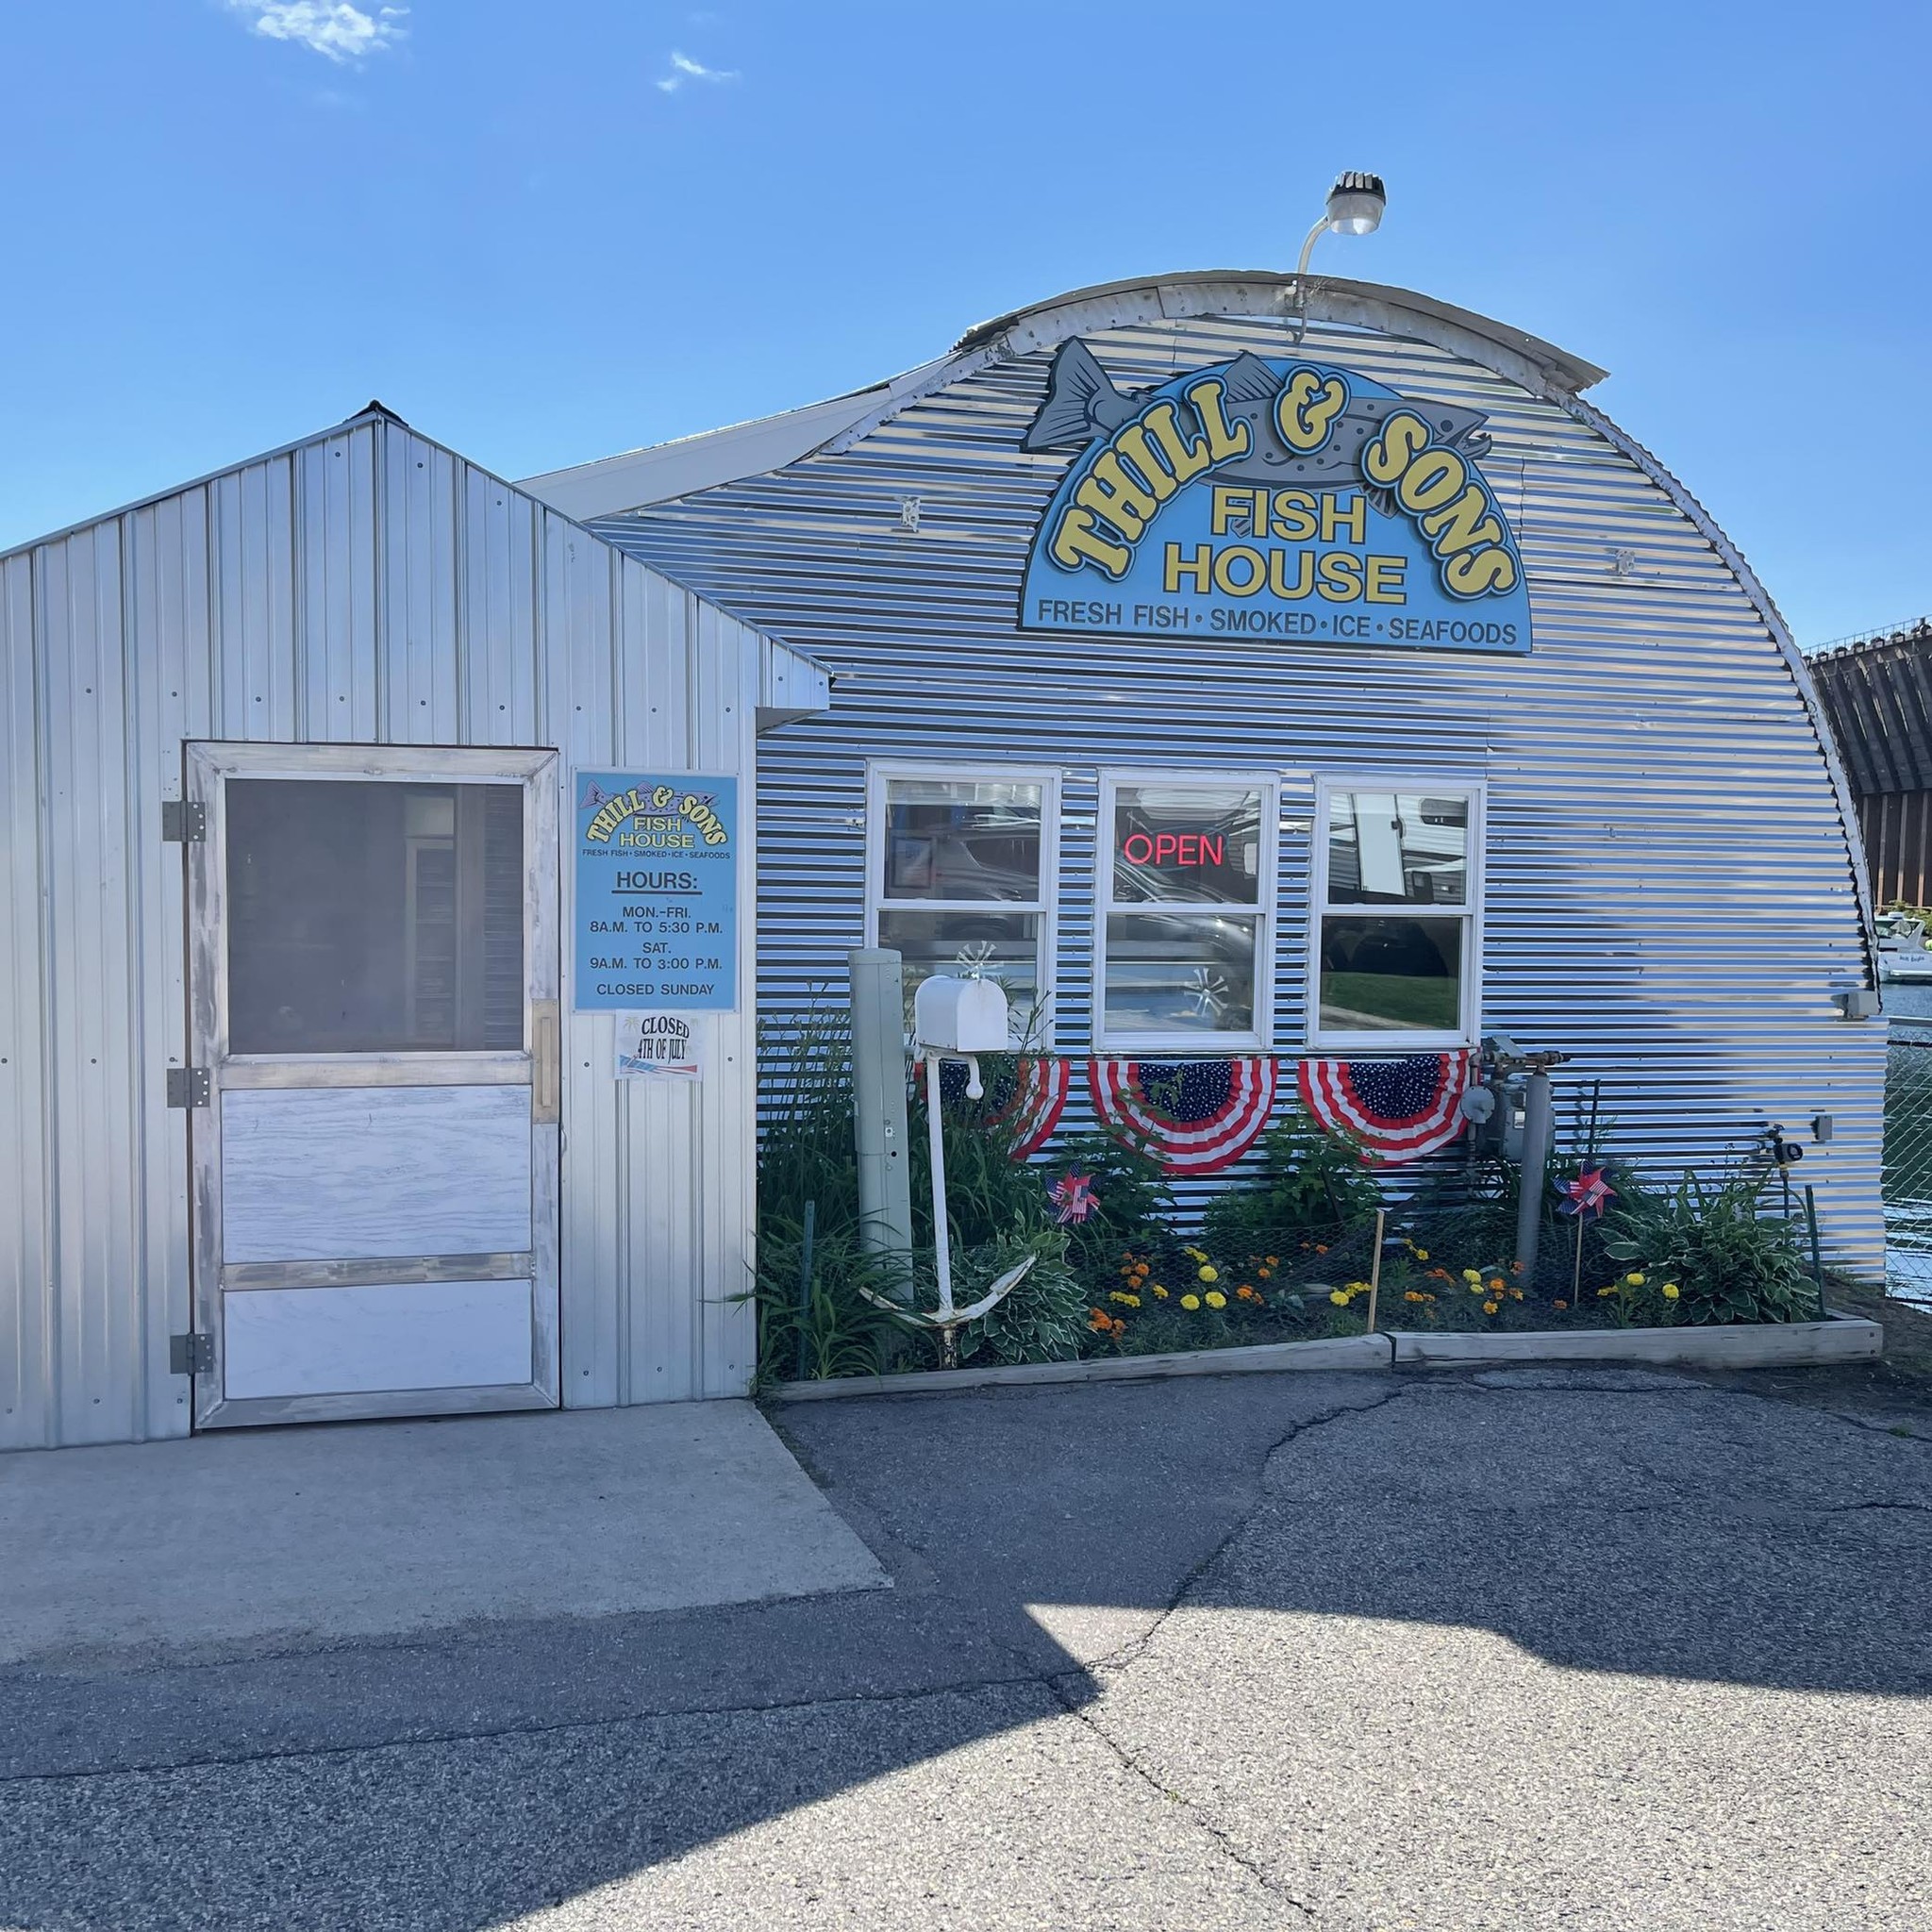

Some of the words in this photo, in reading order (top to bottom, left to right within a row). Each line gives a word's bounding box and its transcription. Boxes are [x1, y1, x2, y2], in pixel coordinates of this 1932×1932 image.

[1050, 378, 1251, 579] THILL
[1276, 369, 1347, 453] &
[1365, 412, 1520, 598] SONS
[1211, 485, 1367, 544] FISH
[1163, 542, 1407, 605] HOUSE
[1039, 599, 1122, 625] FRESH
[1134, 605, 1189, 629] FISH
[1210, 608, 1316, 636] SMOKED
[1333, 615, 1371, 638] ICE
[1389, 618, 1517, 646] SEAFOODS
[586, 789, 645, 842] THILL
[652, 786, 674, 808] &
[678, 794, 727, 845] SONS
[633, 817, 681, 831] FISH
[619, 833, 695, 848] HOUSE
[1124, 833, 1224, 866] OPEN
[616, 872, 698, 889] HOURS:
[623, 907, 691, 918] MON.-FRI.
[590, 921, 627, 933] 8A.M.
[634, 922, 653, 933] TO
[658, 922, 690, 933] 5:30
[695, 923, 723, 934] P.M.
[642, 941, 672, 954] SAT.
[590, 958, 627, 969] 9A.M.
[634, 958, 652, 969] TO
[658, 958, 690, 969] 3:00
[695, 958, 723, 970] P.M.
[596, 984, 655, 995] CLOSED
[660, 984, 715, 995] SUNDAY
[641, 1016, 690, 1039] CLOSED
[638, 1039, 654, 1059] 4TH
[656, 1039, 667, 1059] OF
[668, 1039, 687, 1064] JULY
